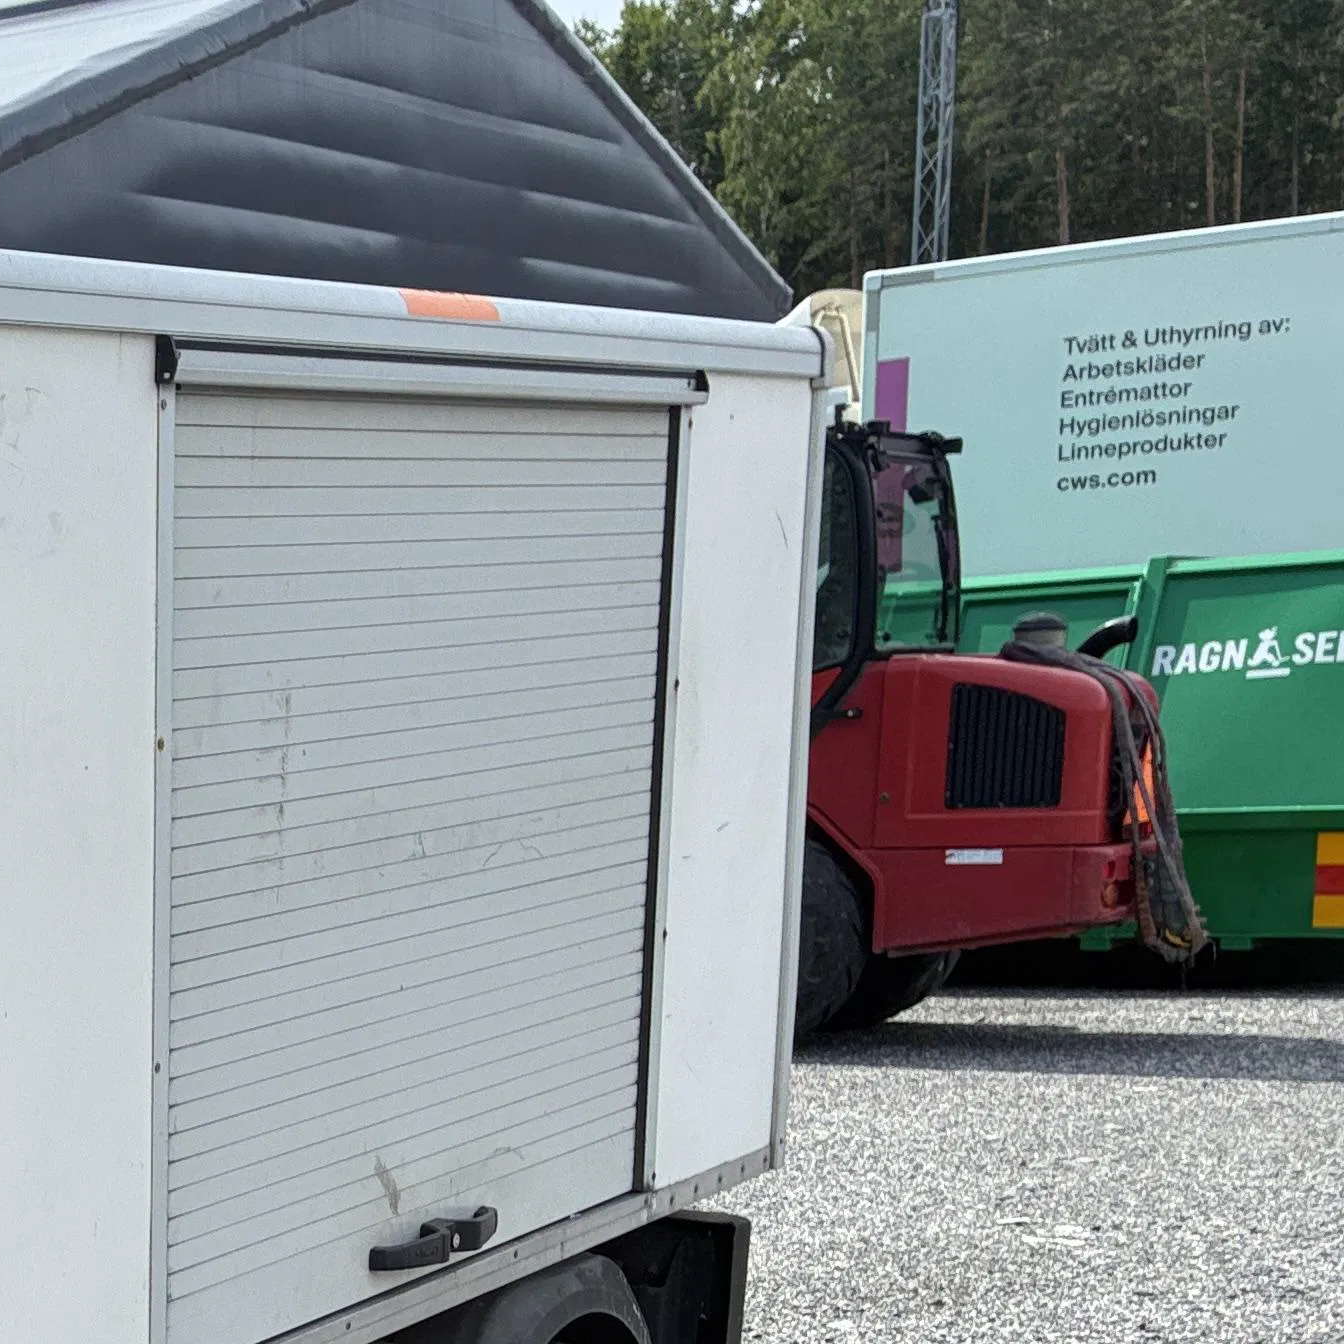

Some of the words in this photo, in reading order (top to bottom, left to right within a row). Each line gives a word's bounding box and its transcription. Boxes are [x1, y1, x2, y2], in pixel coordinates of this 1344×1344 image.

[1064, 334, 1116, 356] Tvätt
[1121, 330, 1137, 350] &
[1144, 320, 1252, 347] Uthyrning
[1062, 352, 1206, 382] Arbetskläder
[1060, 382, 1192, 409] Entrémattor
[1059, 405, 1240, 438] Hygienlösningar
[1058, 433, 1228, 462] Linneprodukter
[1057, 469, 1157, 492] cws.com
